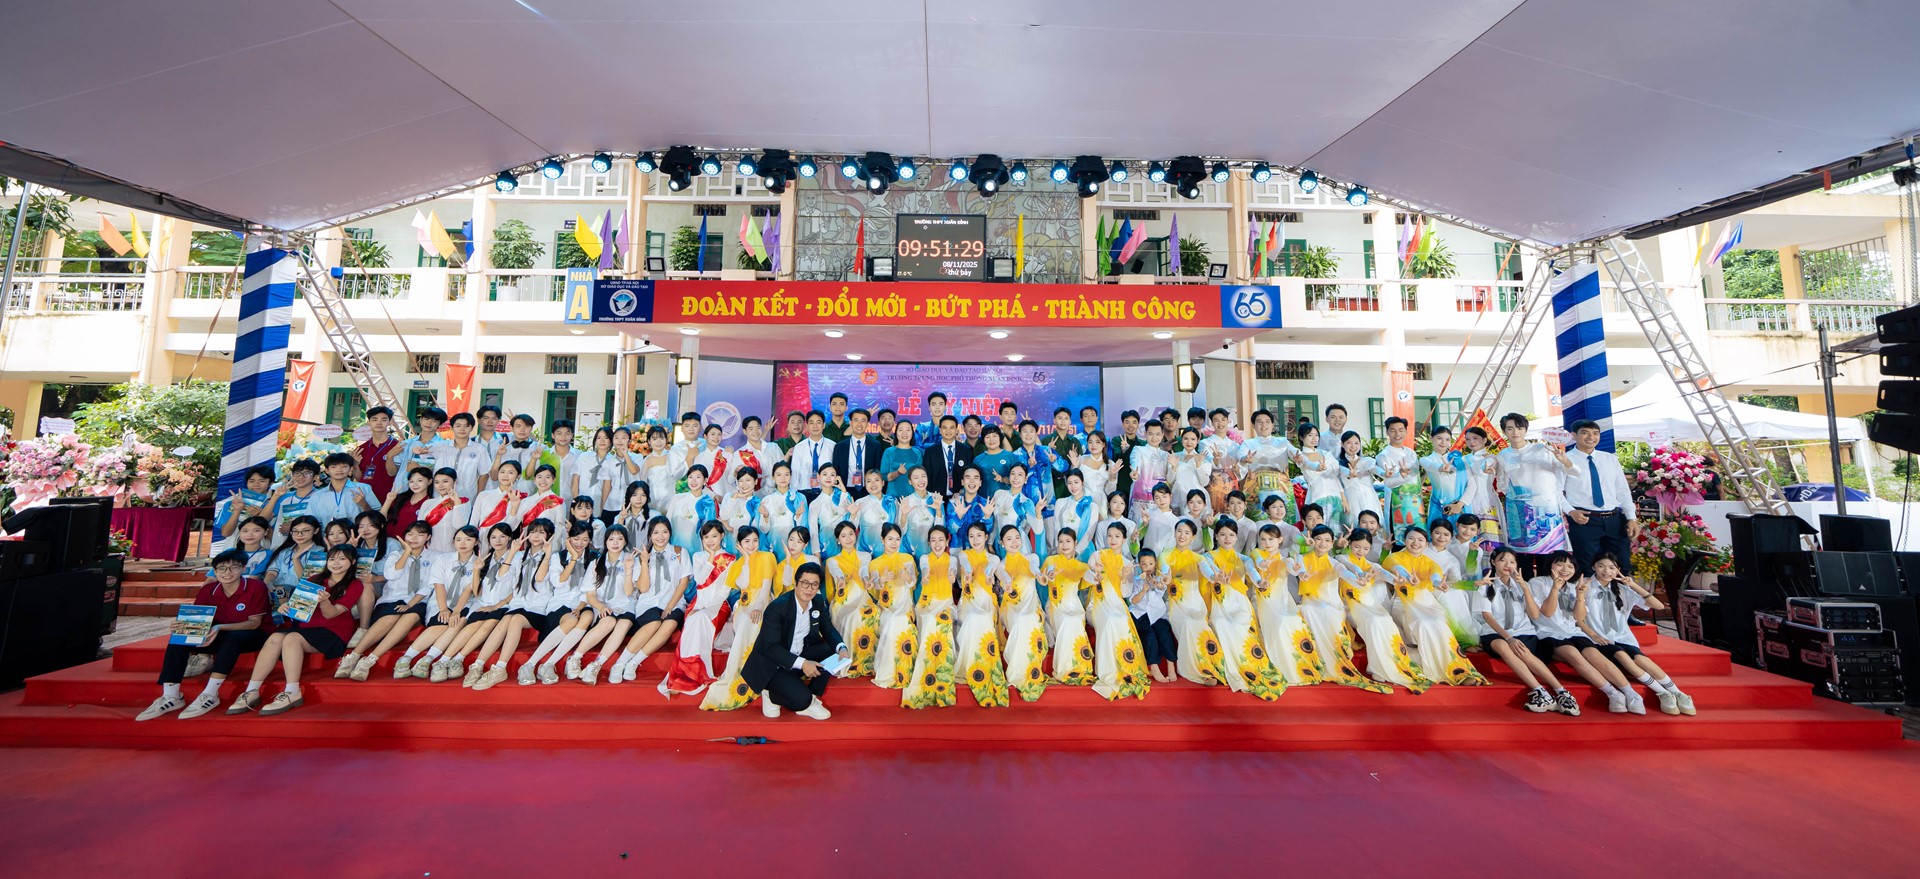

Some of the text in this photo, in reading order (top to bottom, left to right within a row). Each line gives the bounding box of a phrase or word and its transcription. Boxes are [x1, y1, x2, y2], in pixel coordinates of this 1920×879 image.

[898, 240, 984, 258] 09:51:29
[570, 270, 593, 281] NHÀ
[960, 268, 972, 276] bảy
[568, 285, 590, 320] A
[681, 292, 747, 316] ĐOÀN
[752, 288, 799, 316] KẾT
[817, 286, 859, 317] ĐỔI
[865, 292, 907, 317] MỚI
[925, 294, 972, 318] BỨT
[978, 294, 1026, 319] PHÁ
[1045, 294, 1126, 320] THÀNH
[1132, 296, 1196, 320] CÔNG
[1235, 292, 1266, 318] 65
[897, 389, 921, 415] LỄ
